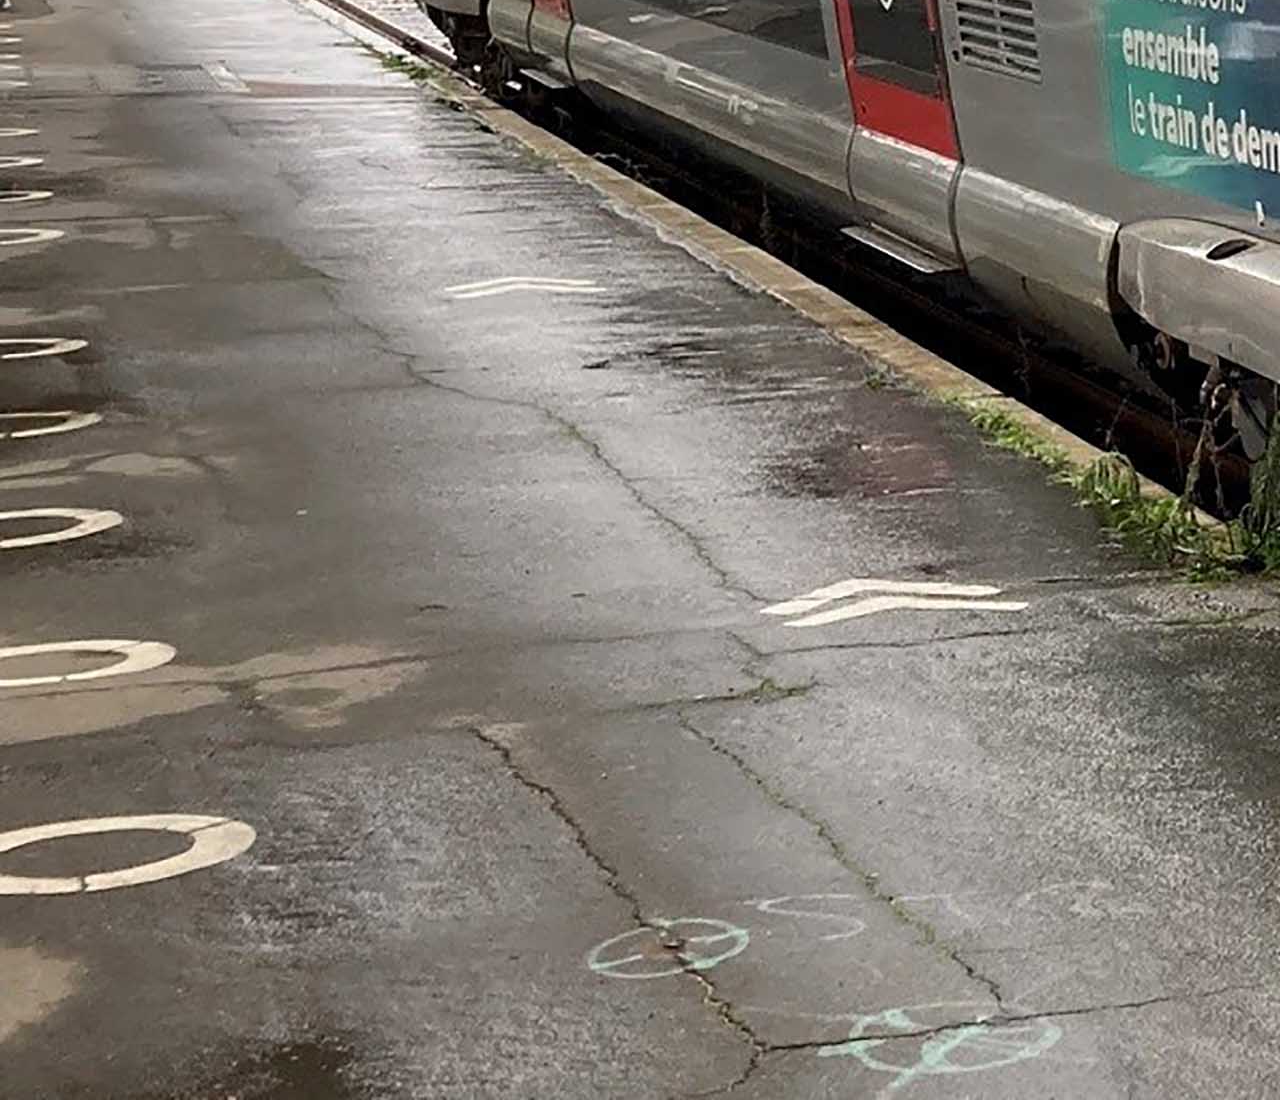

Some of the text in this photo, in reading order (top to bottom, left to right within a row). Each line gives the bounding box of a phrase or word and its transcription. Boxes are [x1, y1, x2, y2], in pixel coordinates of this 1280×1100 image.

[1122, 25, 1220, 85] ensemble
[1128, 83, 1146, 136] le
[1148, 92, 1198, 150] train
[1201, 102, 1231, 159] de
